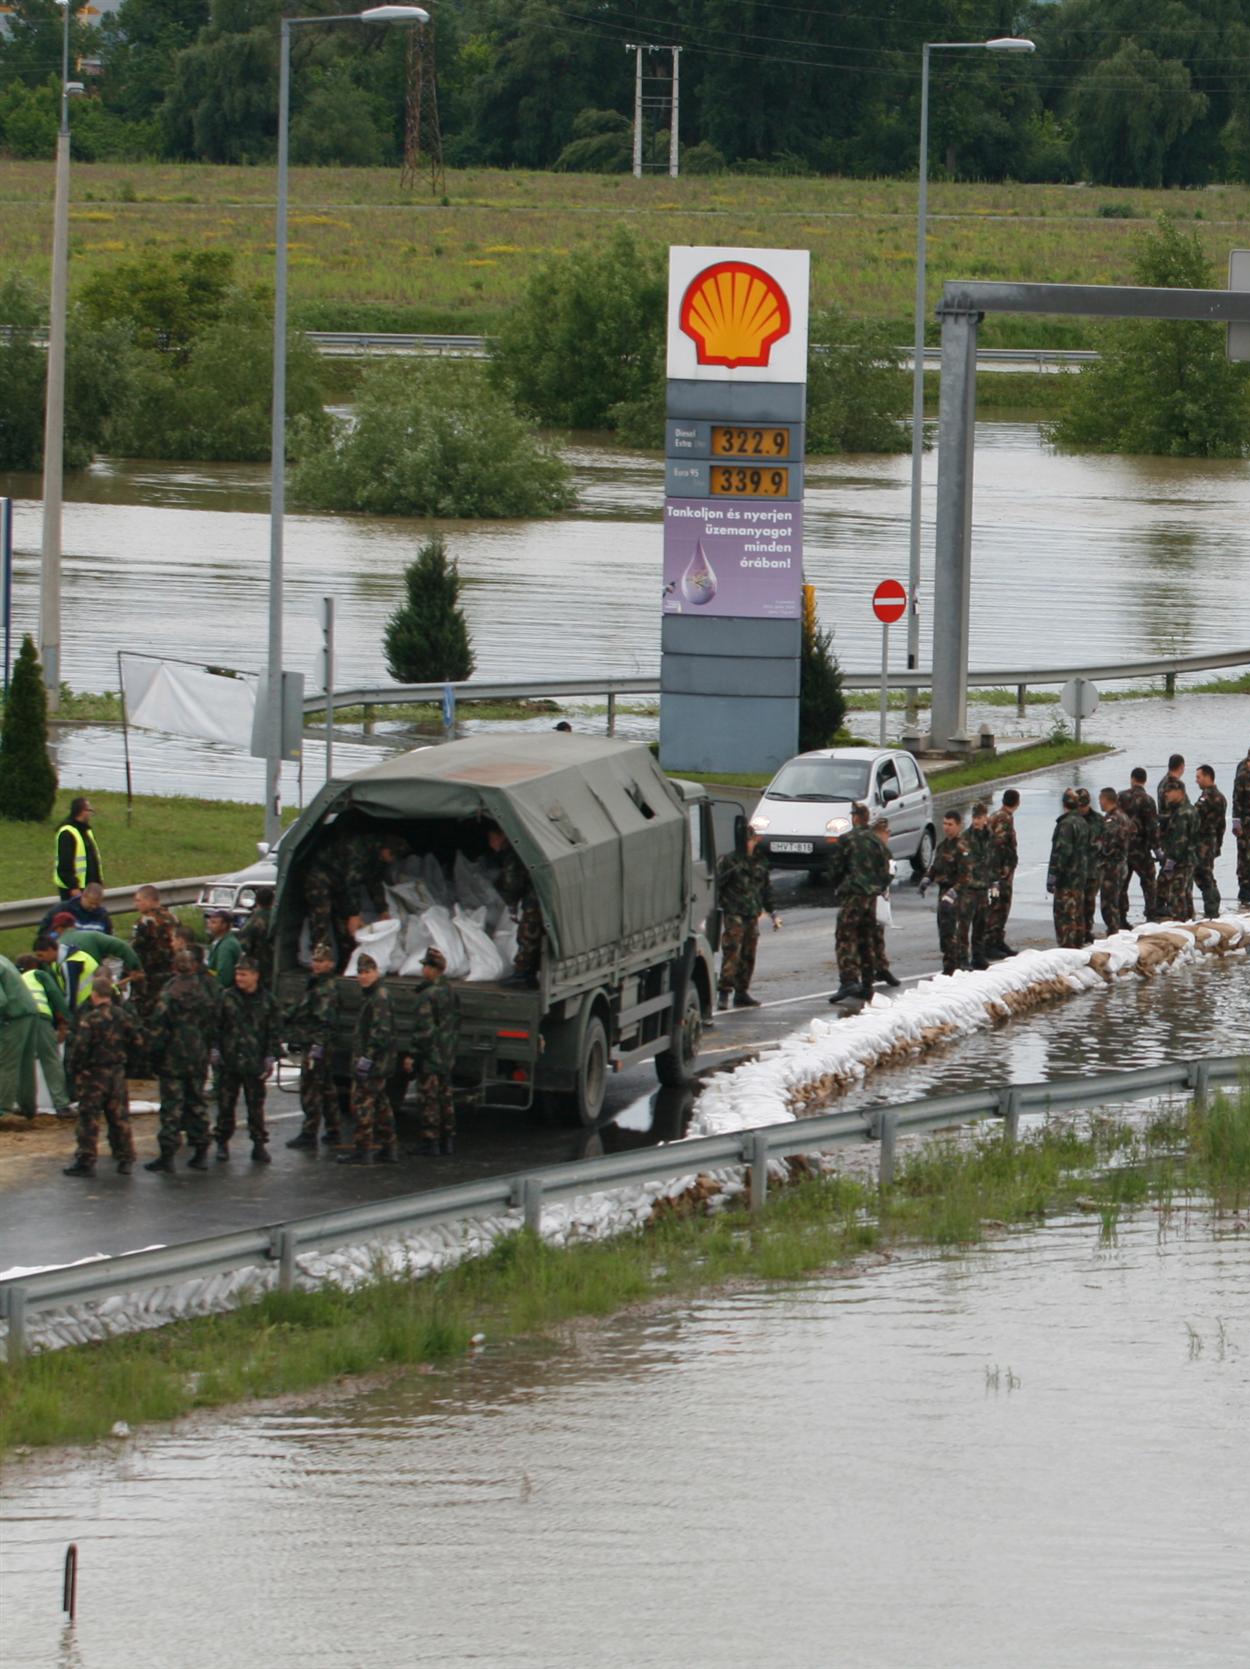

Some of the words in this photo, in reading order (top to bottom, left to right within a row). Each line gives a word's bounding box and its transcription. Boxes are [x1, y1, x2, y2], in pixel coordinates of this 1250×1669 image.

[675, 428, 696, 437] Diesel
[675, 439, 692, 448] Extra
[722, 430, 785, 454] 322.9
[721, 469, 783, 494] 339.9
[667, 506, 724, 521] Tankoljon
[727, 508, 741, 519] és
[744, 509, 793, 523] nyerjen
[705, 524, 792, 539] üzemanyagot
[744, 541, 792, 552] minden
[740, 557, 792, 569] órában!
